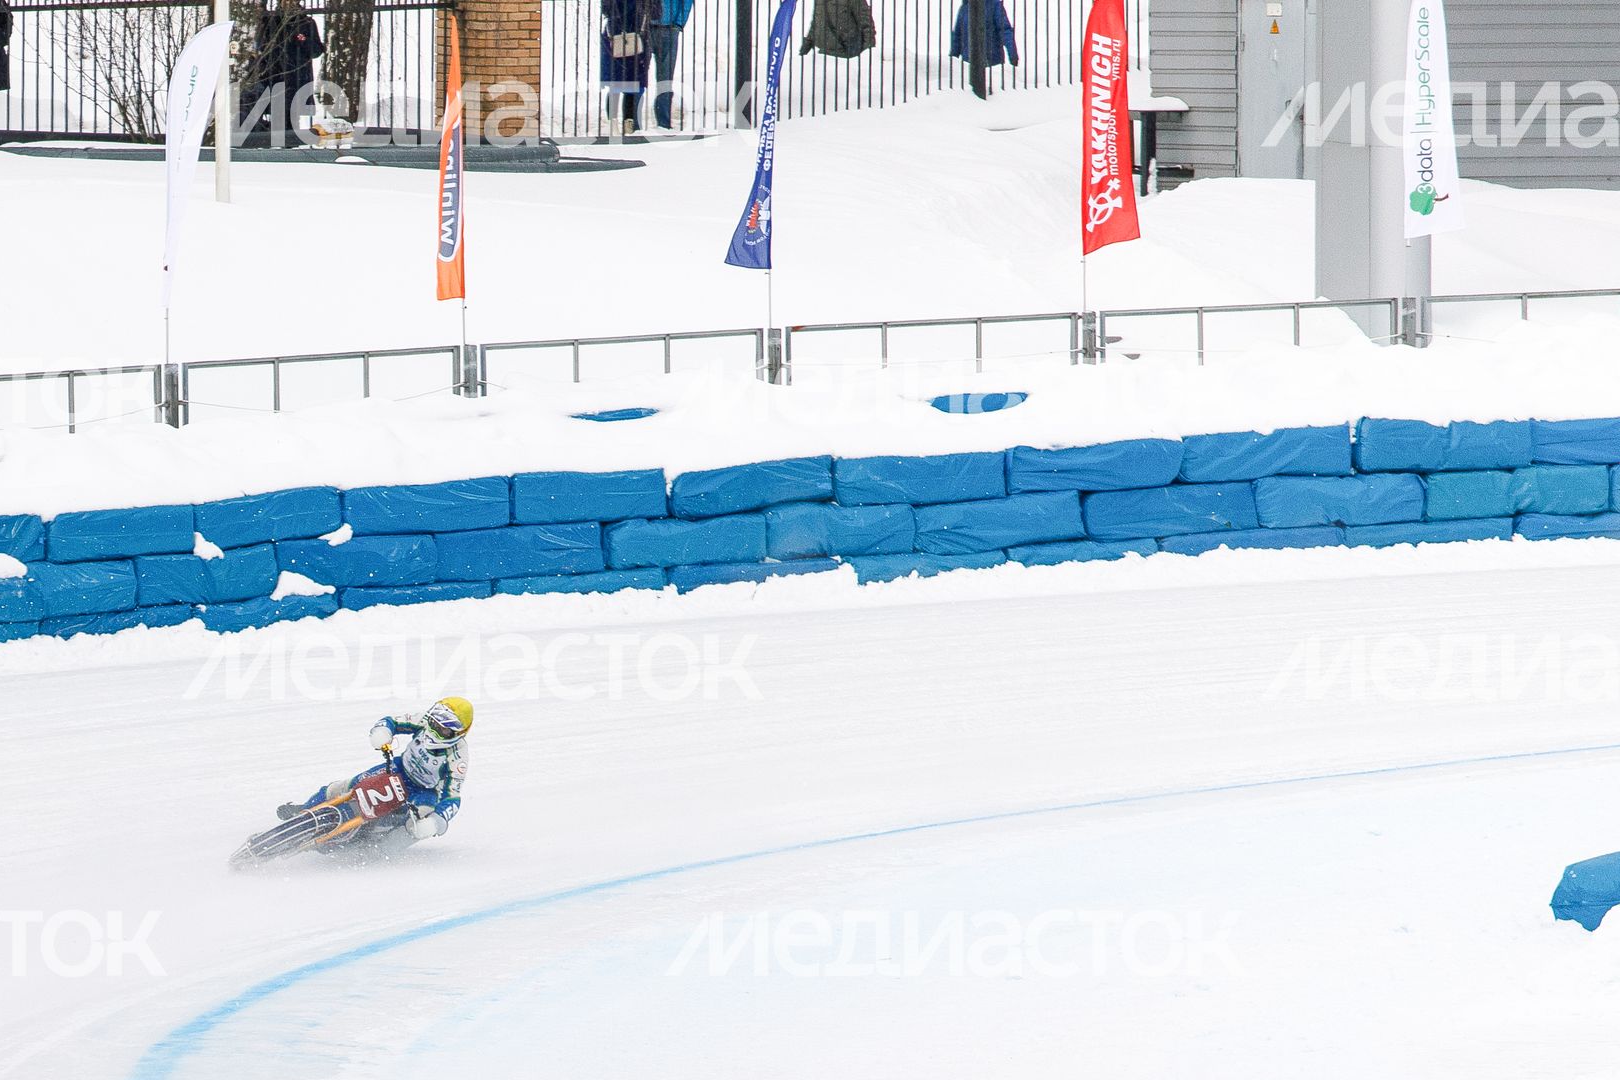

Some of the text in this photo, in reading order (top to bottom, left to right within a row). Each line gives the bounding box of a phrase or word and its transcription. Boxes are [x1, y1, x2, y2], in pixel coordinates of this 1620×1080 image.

[1111, 39, 1122, 81] yms.ru
[1091, 32, 1113, 185] YAKHNICH
[1416, 138, 1434, 195] 3data
[366, 785, 395, 806] 2
